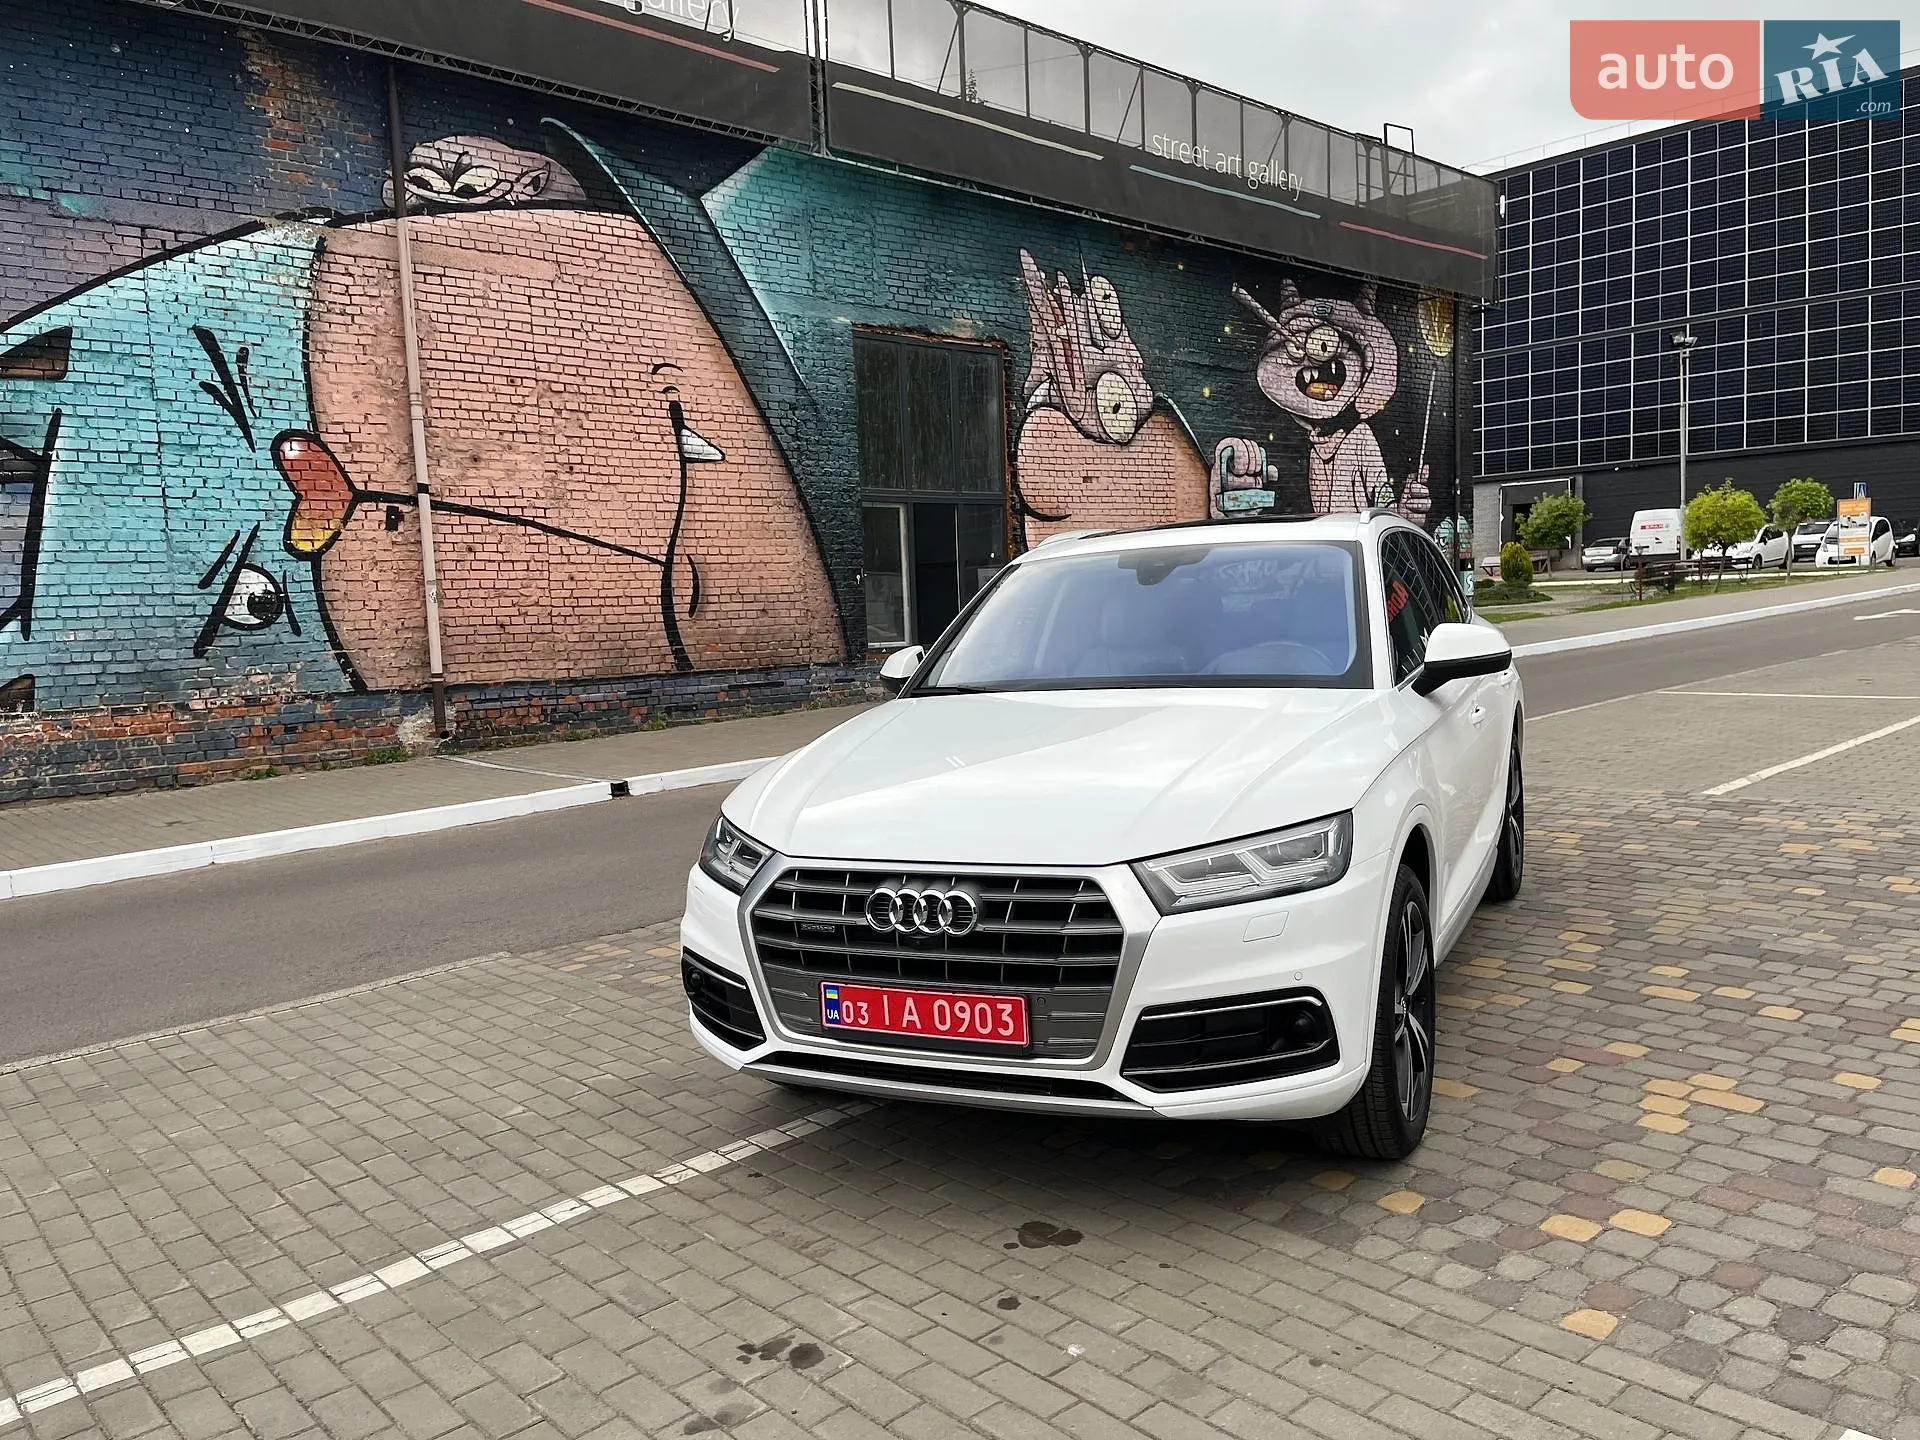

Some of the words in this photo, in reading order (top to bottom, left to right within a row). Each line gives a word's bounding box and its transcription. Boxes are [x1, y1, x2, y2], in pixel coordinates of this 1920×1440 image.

[1152, 133, 1210, 171] street
[1215, 152, 1243, 179] art
[1247, 160, 1303, 201] gallery
[826, 1009, 840, 1020] UA
[842, 1000, 869, 1025] 03
[932, 999, 1015, 1037] 0903
